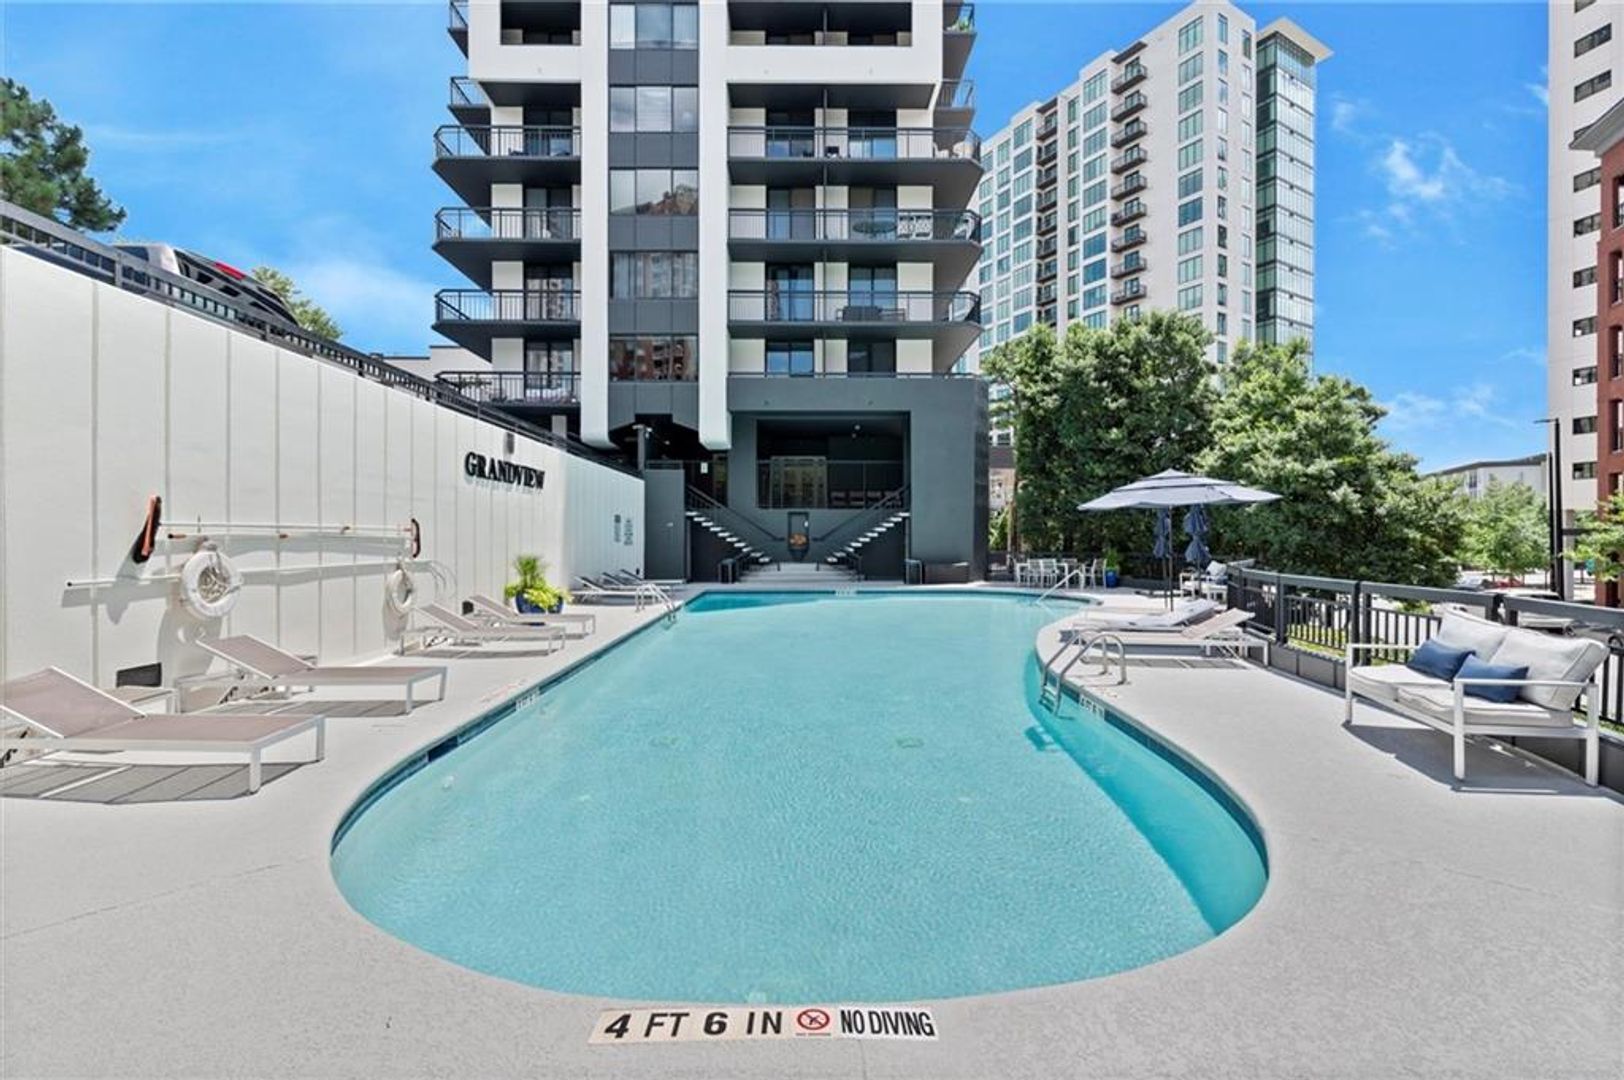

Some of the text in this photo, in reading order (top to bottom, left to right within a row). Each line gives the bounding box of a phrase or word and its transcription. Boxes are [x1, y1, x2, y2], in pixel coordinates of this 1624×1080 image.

[465, 451, 545, 489] GRANDVIEW
[604, 1009, 935, 1039] 4 FT 6 IN NO DIVING
